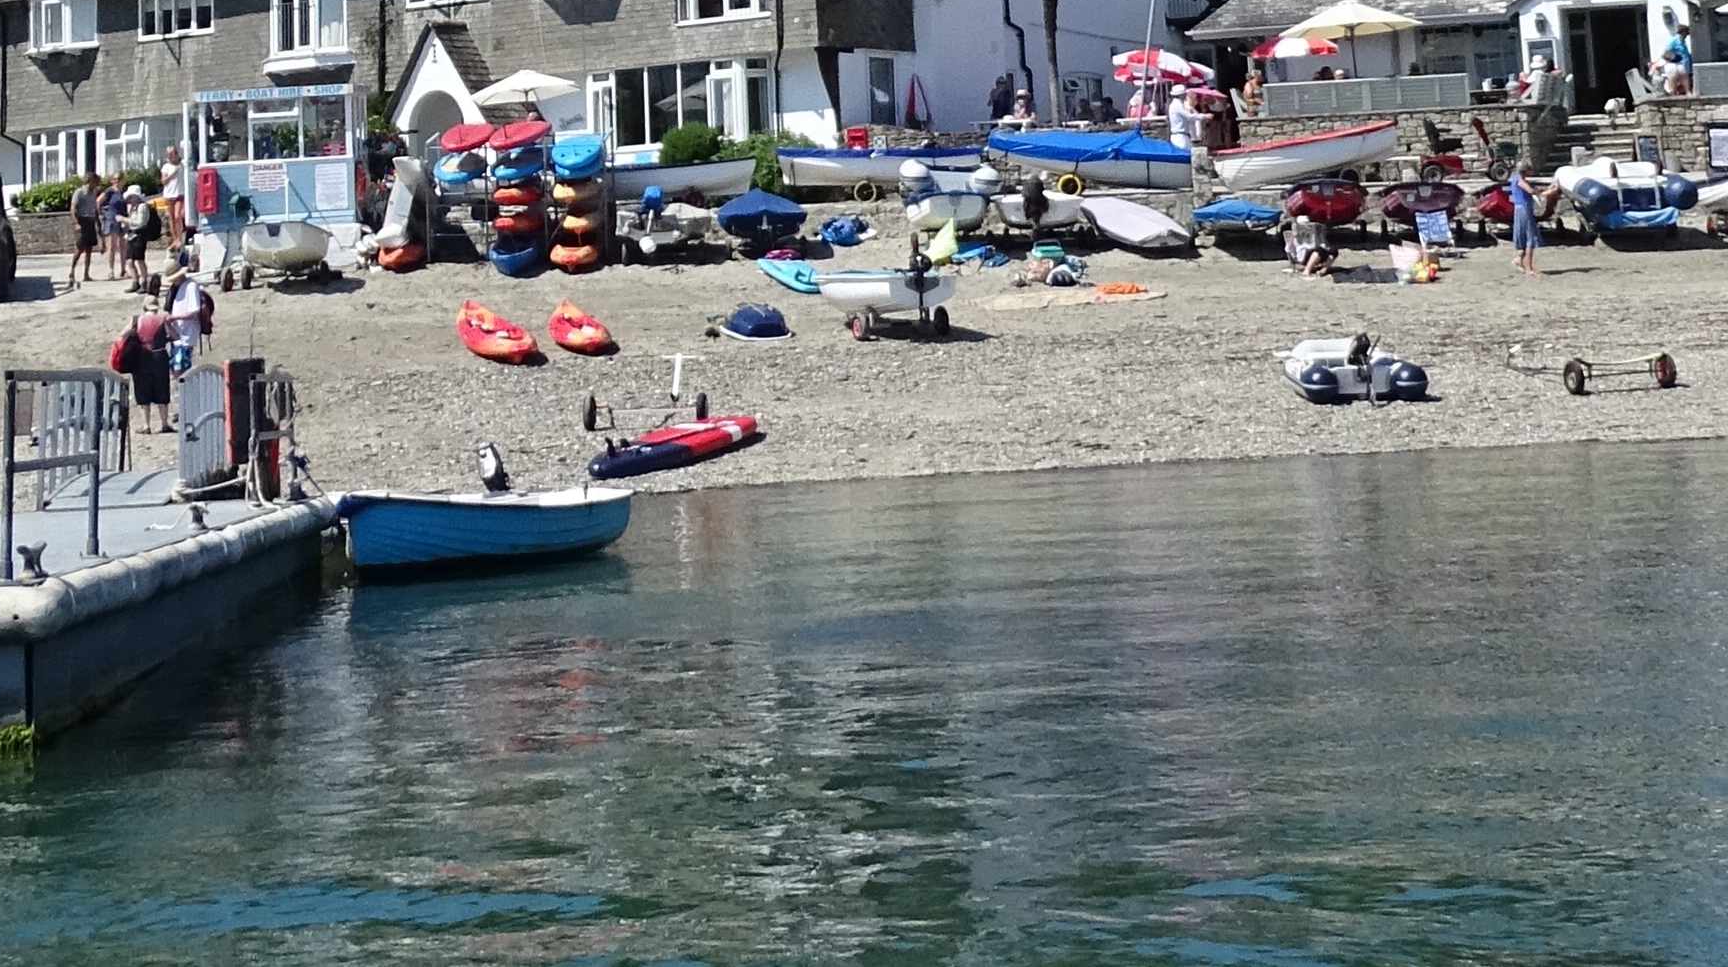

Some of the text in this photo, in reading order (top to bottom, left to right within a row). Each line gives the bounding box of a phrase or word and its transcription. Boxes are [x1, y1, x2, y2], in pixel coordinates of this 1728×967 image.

[199, 84, 344, 102] FERRY BOAT HIRE SHOP
[252, 162, 283, 172] DANGER
